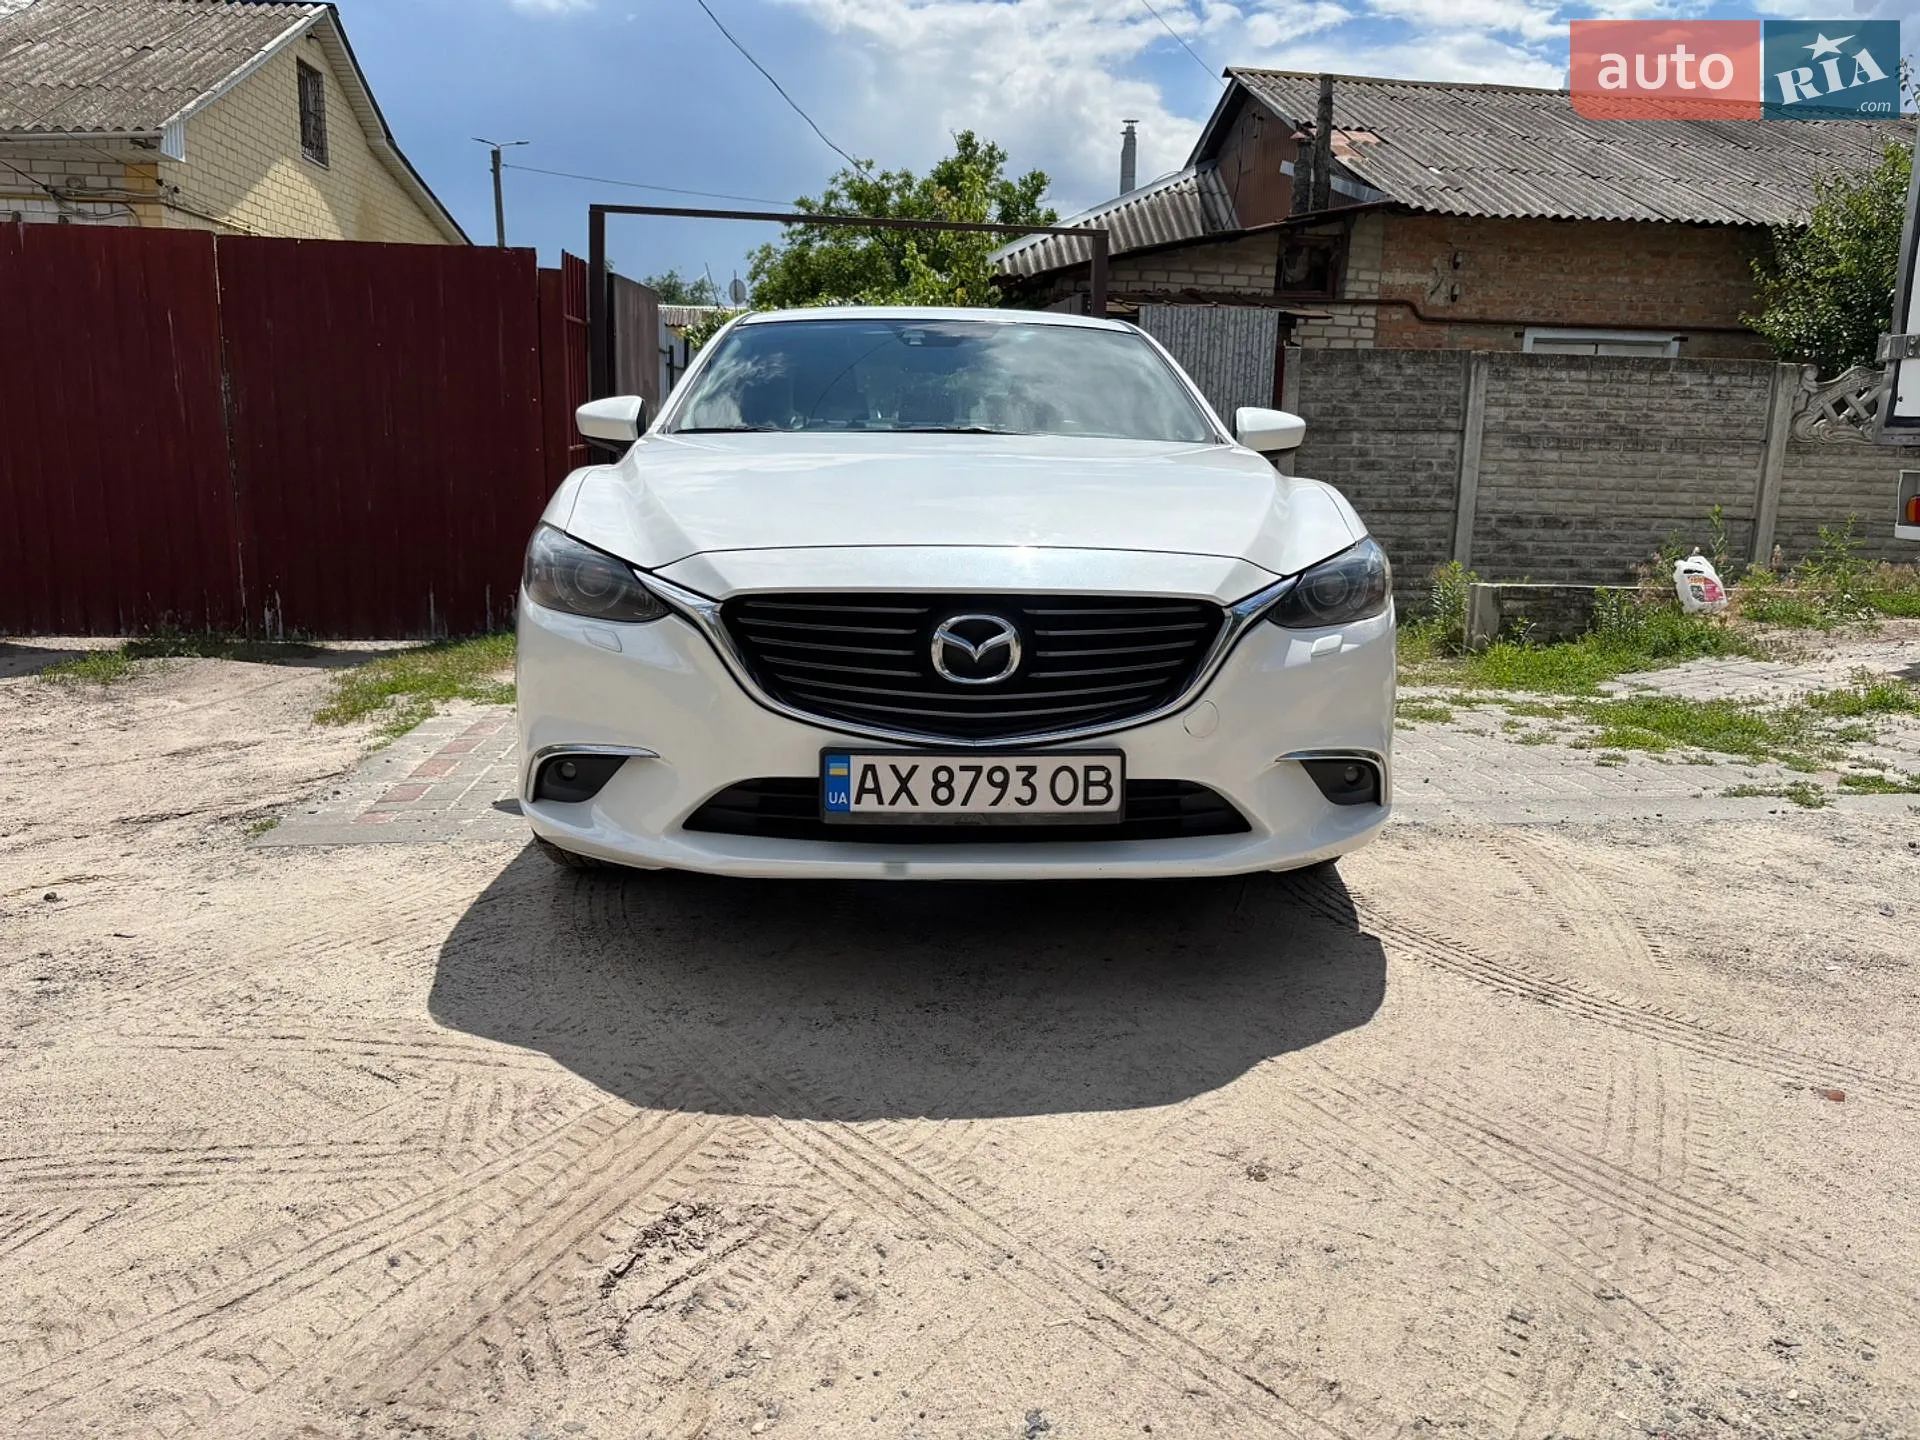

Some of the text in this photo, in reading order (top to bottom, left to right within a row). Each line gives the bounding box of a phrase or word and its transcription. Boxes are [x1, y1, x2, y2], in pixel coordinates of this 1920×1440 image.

[828, 791, 848, 805] UA
[854, 764, 1114, 807] AX 8793 OB
